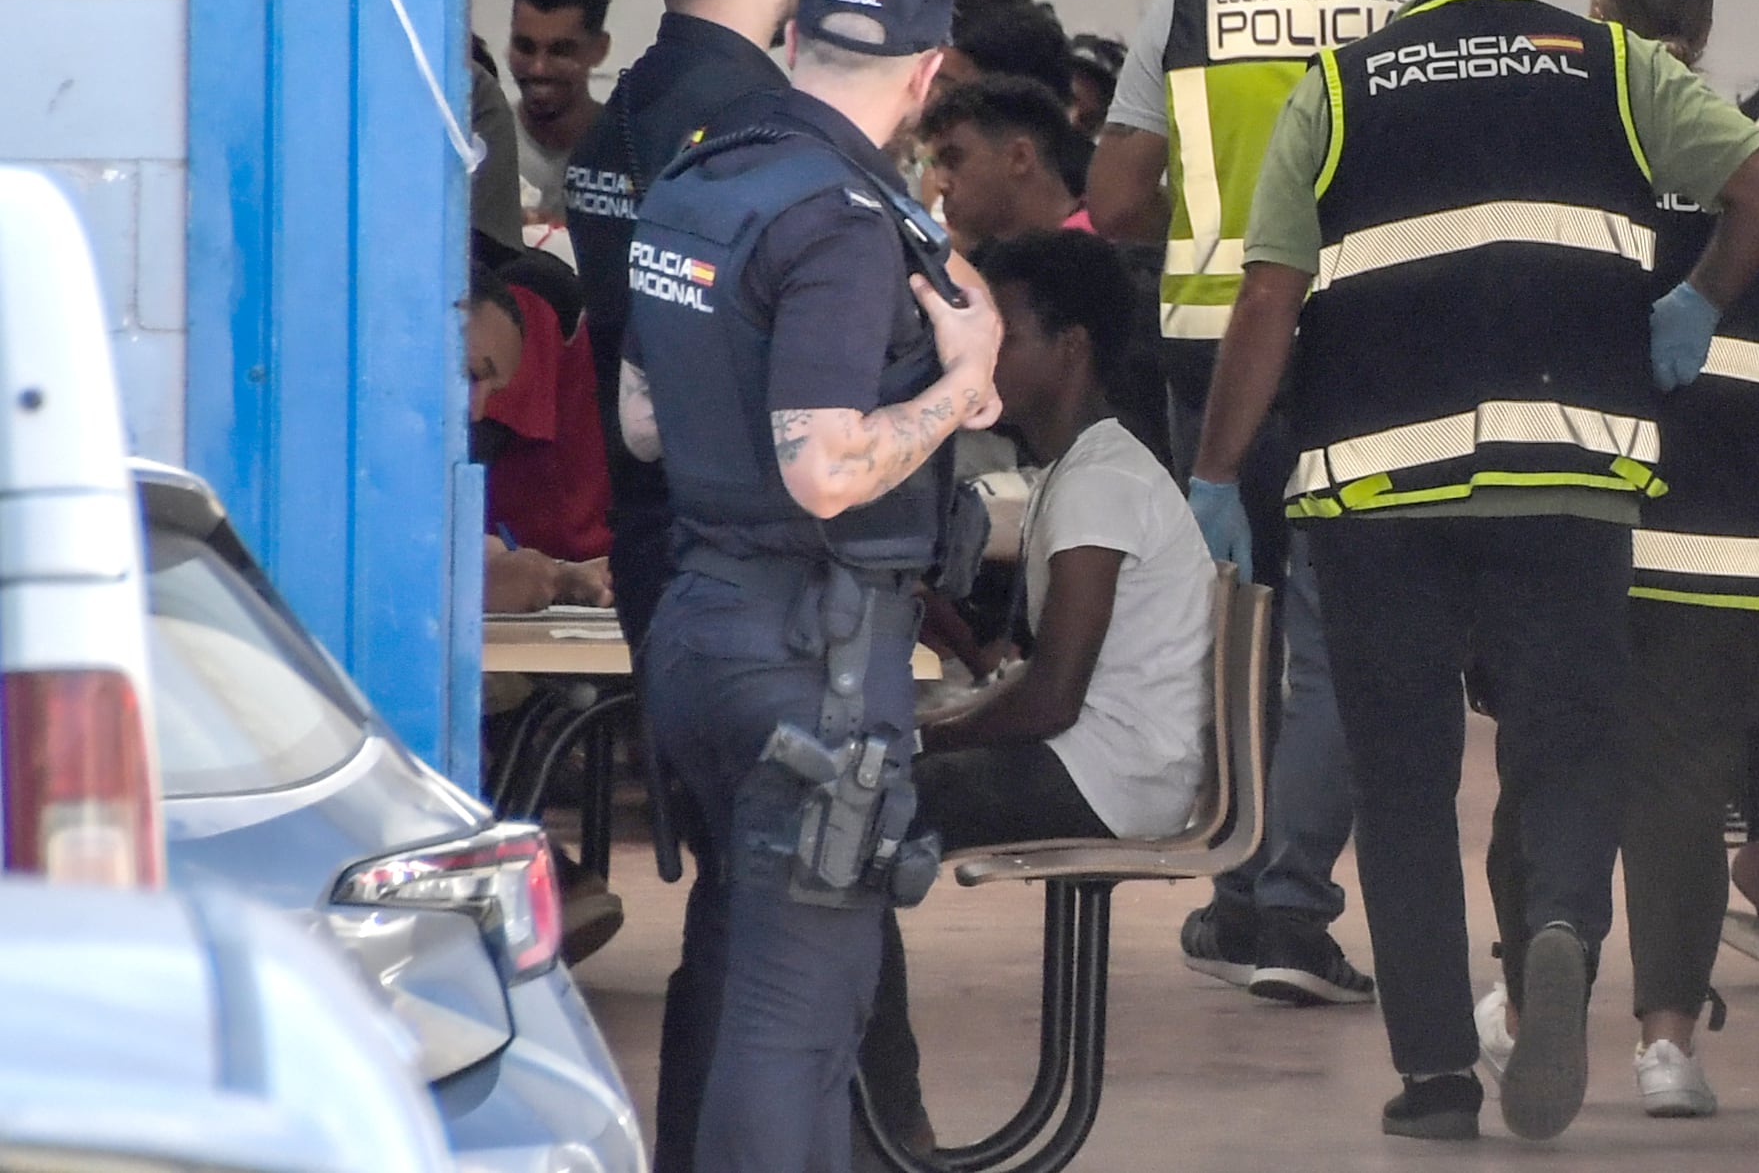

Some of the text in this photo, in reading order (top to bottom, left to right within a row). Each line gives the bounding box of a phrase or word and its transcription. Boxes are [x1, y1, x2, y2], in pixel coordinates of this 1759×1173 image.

[1365, 35, 1537, 75] POLICIA
[1368, 54, 1589, 97] NACIONAL
[565, 165, 626, 194] POLICIA
[628, 240, 693, 281] POLICIA
[628, 266, 714, 314] NACIONAL
